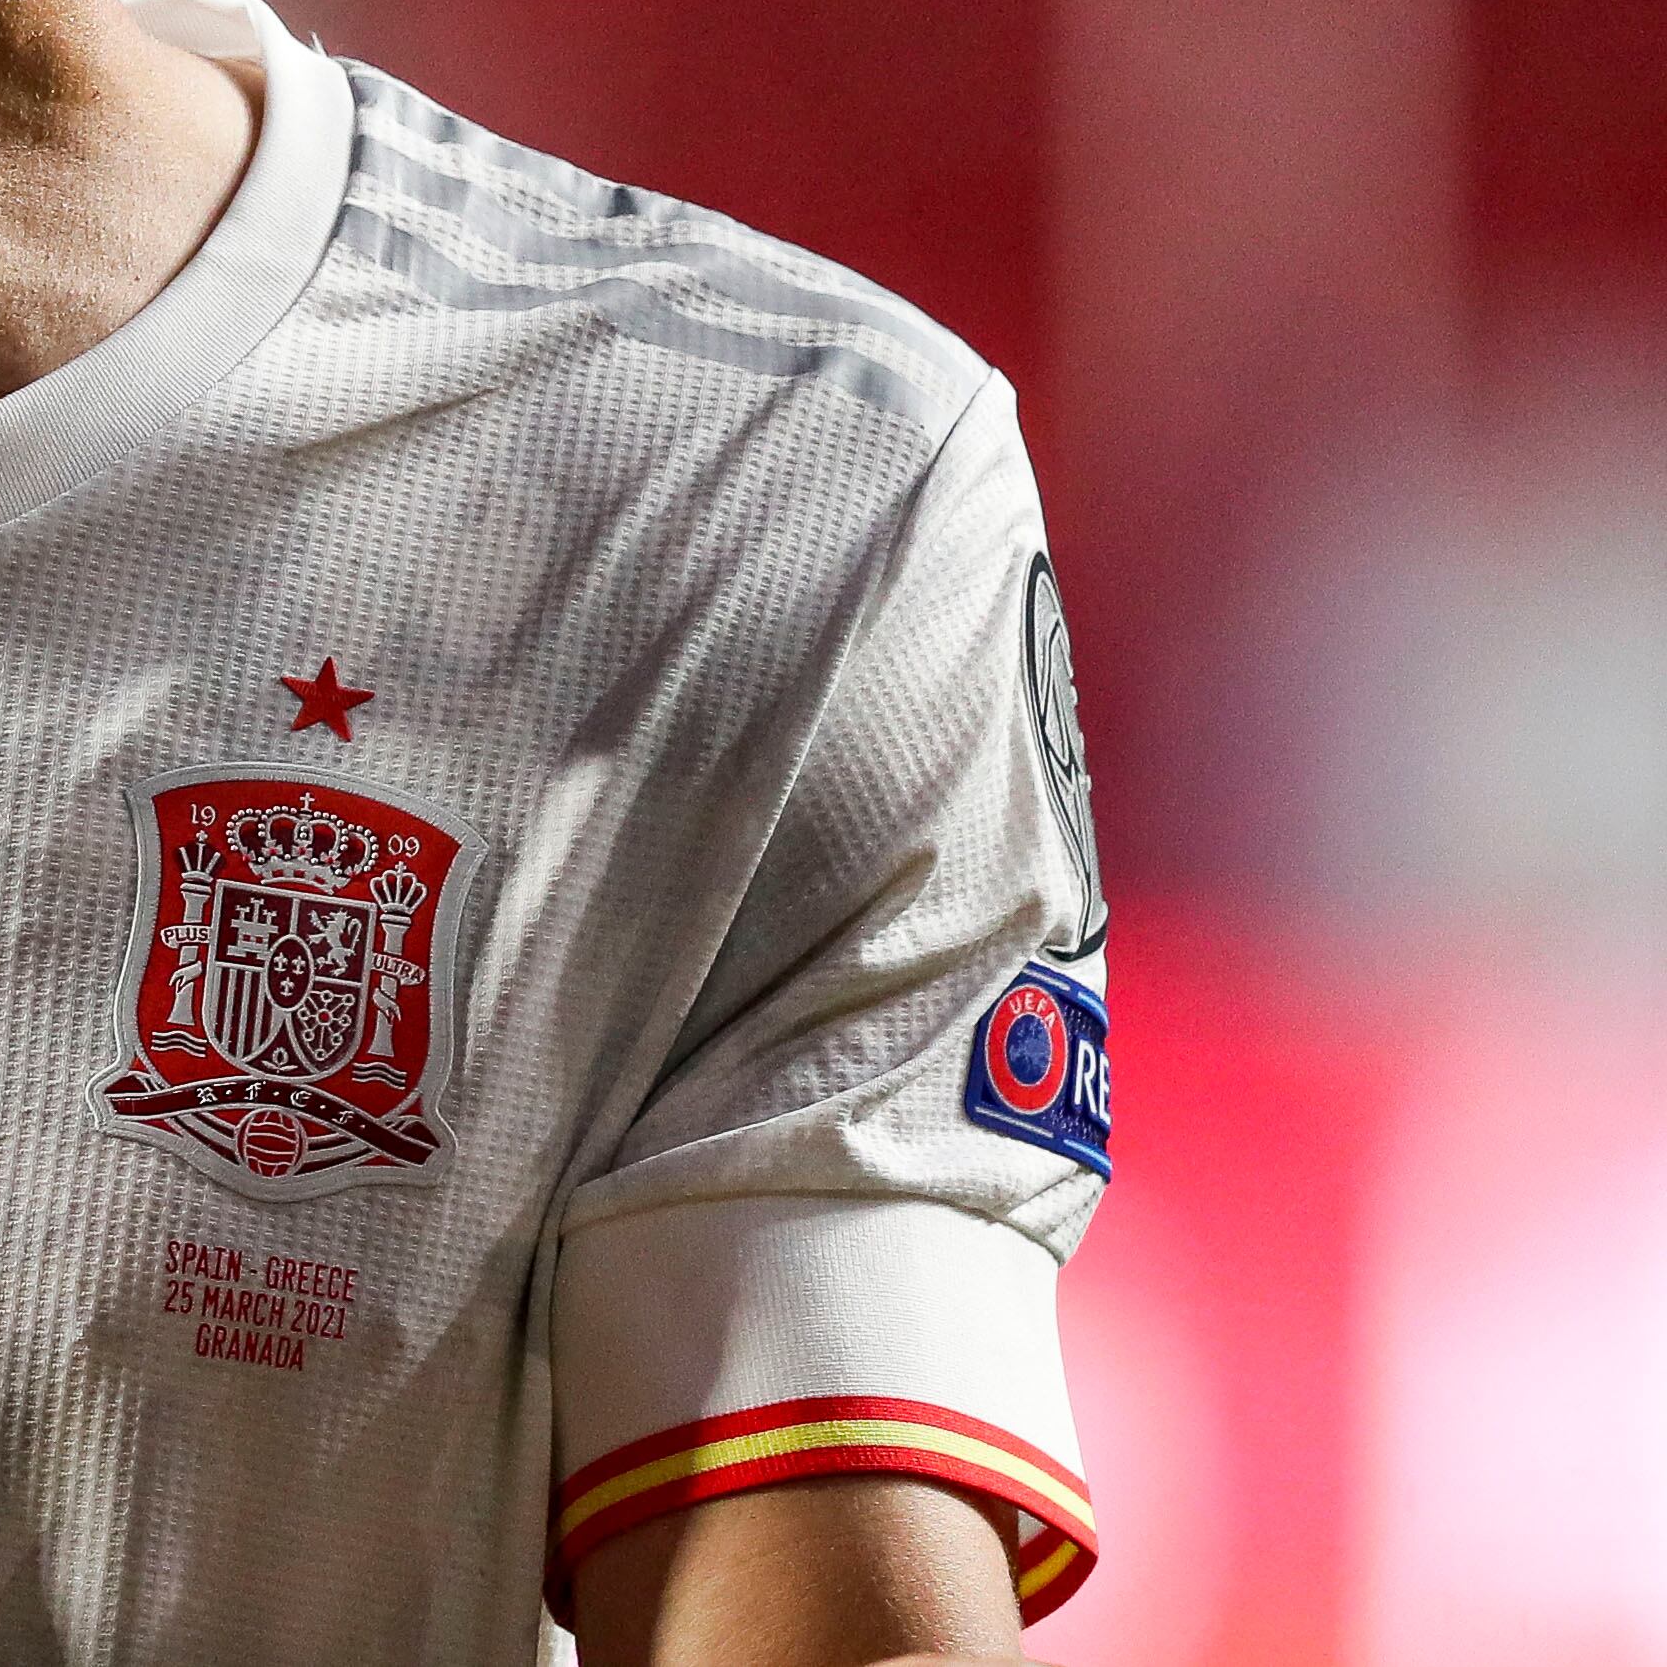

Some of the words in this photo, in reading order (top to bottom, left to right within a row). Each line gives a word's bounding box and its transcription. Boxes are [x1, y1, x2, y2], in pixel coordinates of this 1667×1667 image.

[191, 803, 216, 827] 19
[387, 834, 421, 857] 09
[165, 926, 209, 941] PLUS
[371, 953, 425, 982] ULTRA
[1009, 991, 1058, 1029] UEFA
[165, 1240, 243, 1282] SPAIN
[265, 1255, 359, 1302] GREECE
[163, 1279, 196, 1315] 25
[201, 1285, 285, 1328] MARCH
[290, 1300, 346, 1340] 2021
[195, 1322, 305, 1372] GRANADA
